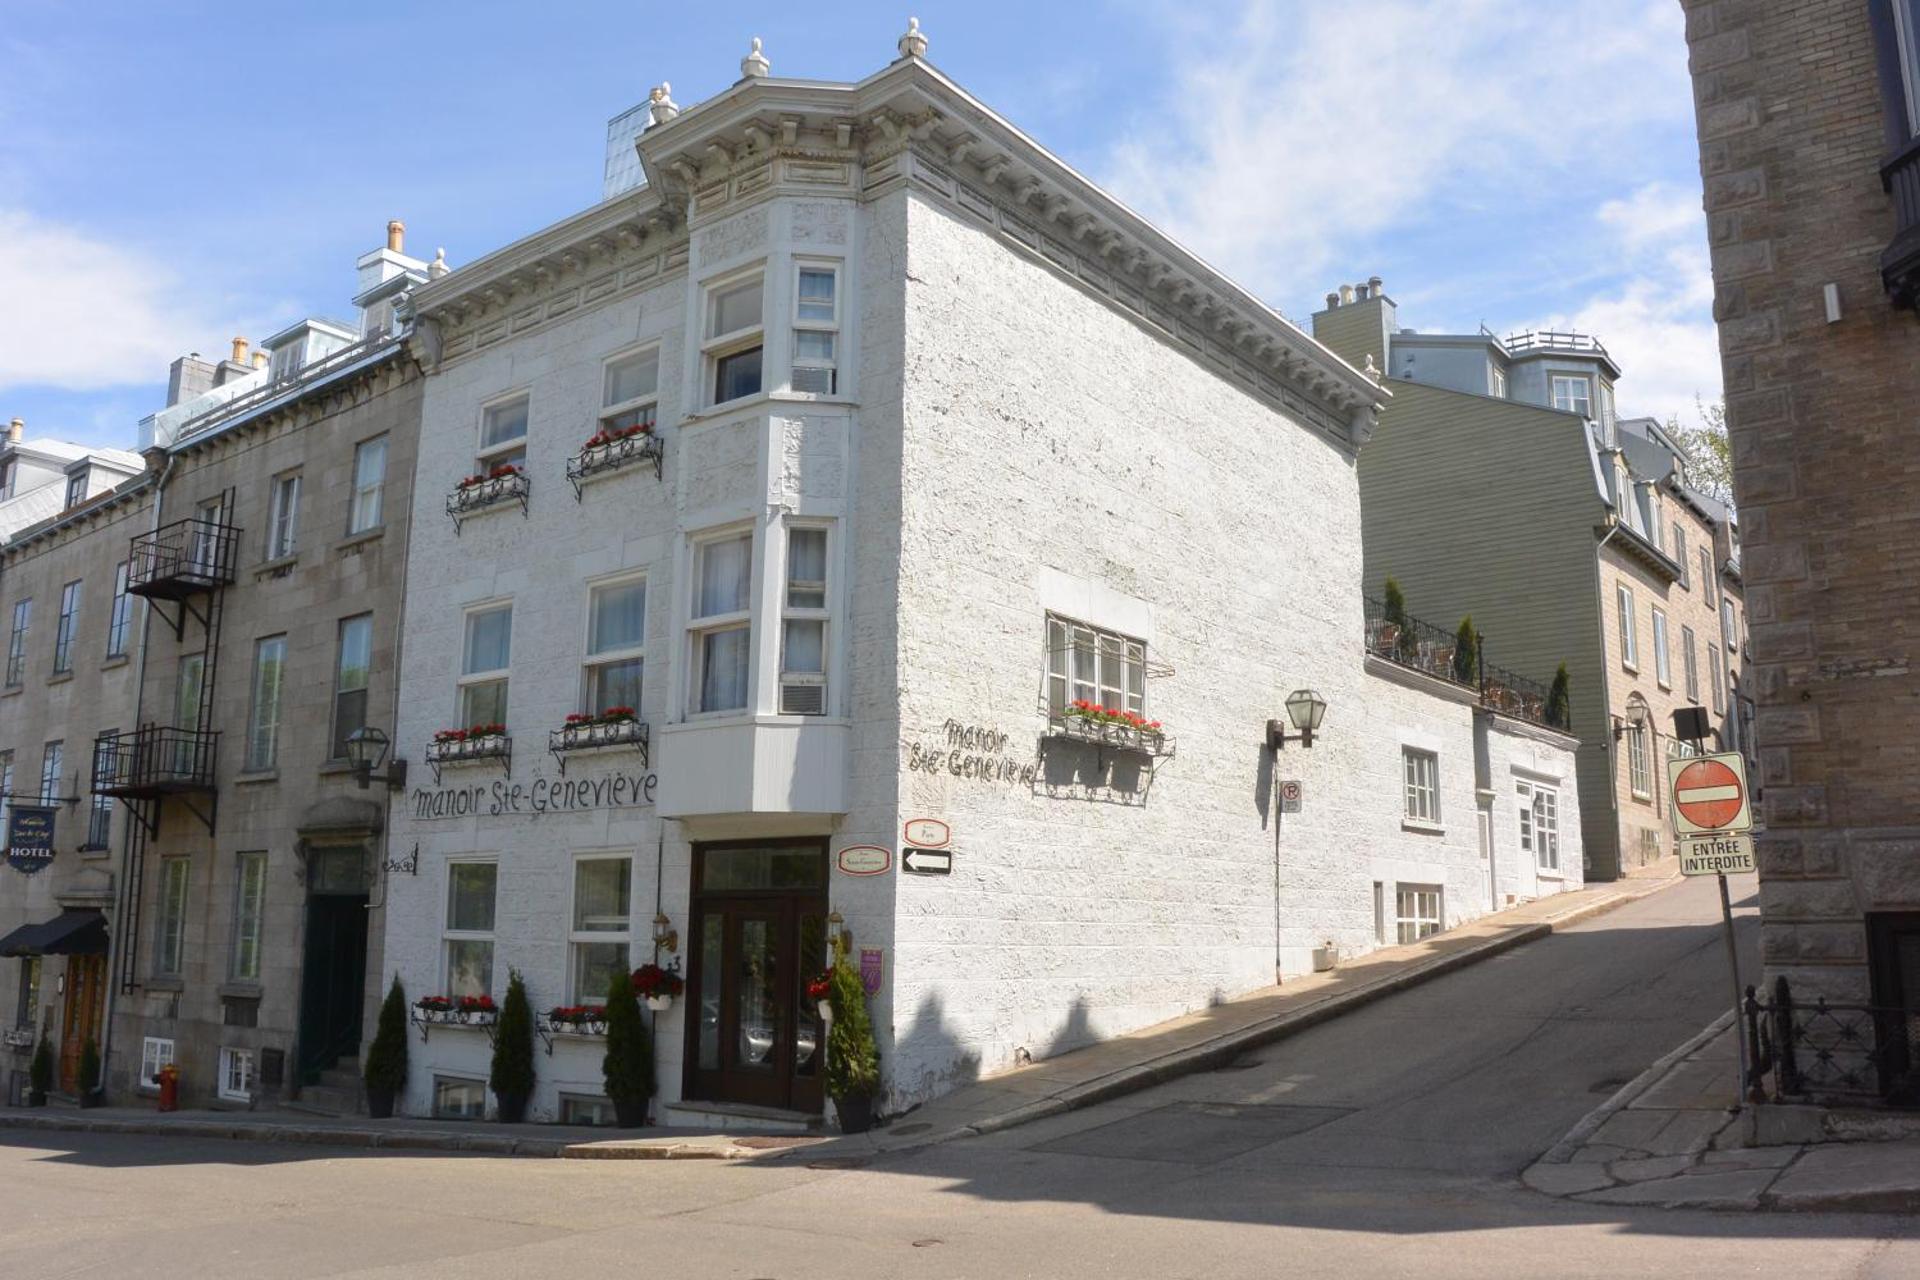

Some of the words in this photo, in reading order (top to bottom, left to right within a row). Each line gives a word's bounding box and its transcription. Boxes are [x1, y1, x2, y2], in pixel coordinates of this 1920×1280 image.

[10, 847, 53, 857] HOTEL
[1692, 839, 1740, 856] ENTRÉE
[1685, 854, 1752, 871] INTERDITE
